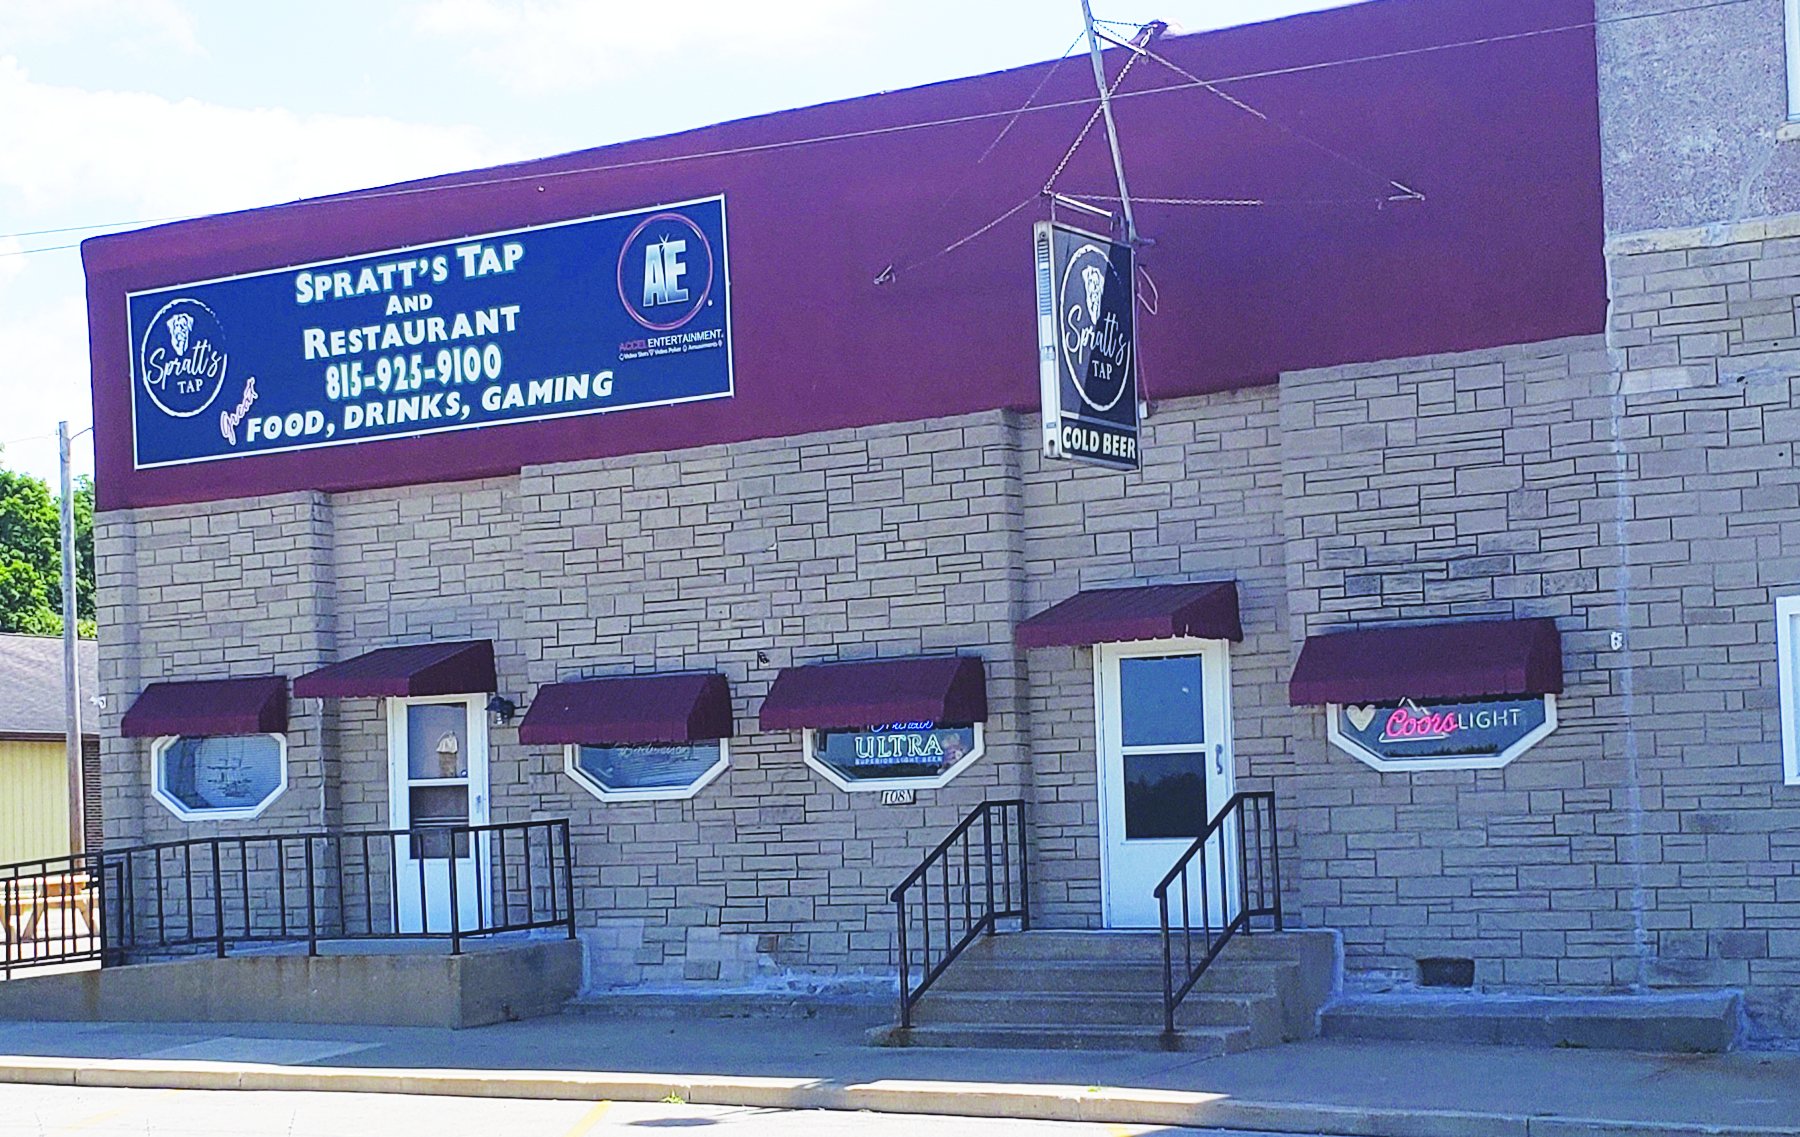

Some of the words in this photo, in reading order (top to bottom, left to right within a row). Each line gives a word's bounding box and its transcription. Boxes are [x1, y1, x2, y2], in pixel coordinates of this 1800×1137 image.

[456, 243, 525, 278] TAP
[643, 238, 689, 307] AE
[385, 293, 433, 316] AND
[303, 305, 520, 360] RESTAURANT
[177, 379, 204, 394] TAP
[325, 343, 503, 400] 815-925-9100
[1092, 359, 1113, 381] TAP
[246, 409, 336, 442] FOOD,
[343, 389, 471, 430] DRINKS,
[481, 370, 614, 412] GAMING
[1062, 426, 1100, 451] COLD
[1103, 433, 1136, 460] BEER
[1386, 708, 1458, 737] Coors
[1459, 708, 1520, 731] LIGHT
[854, 733, 944, 758] ULTRA
